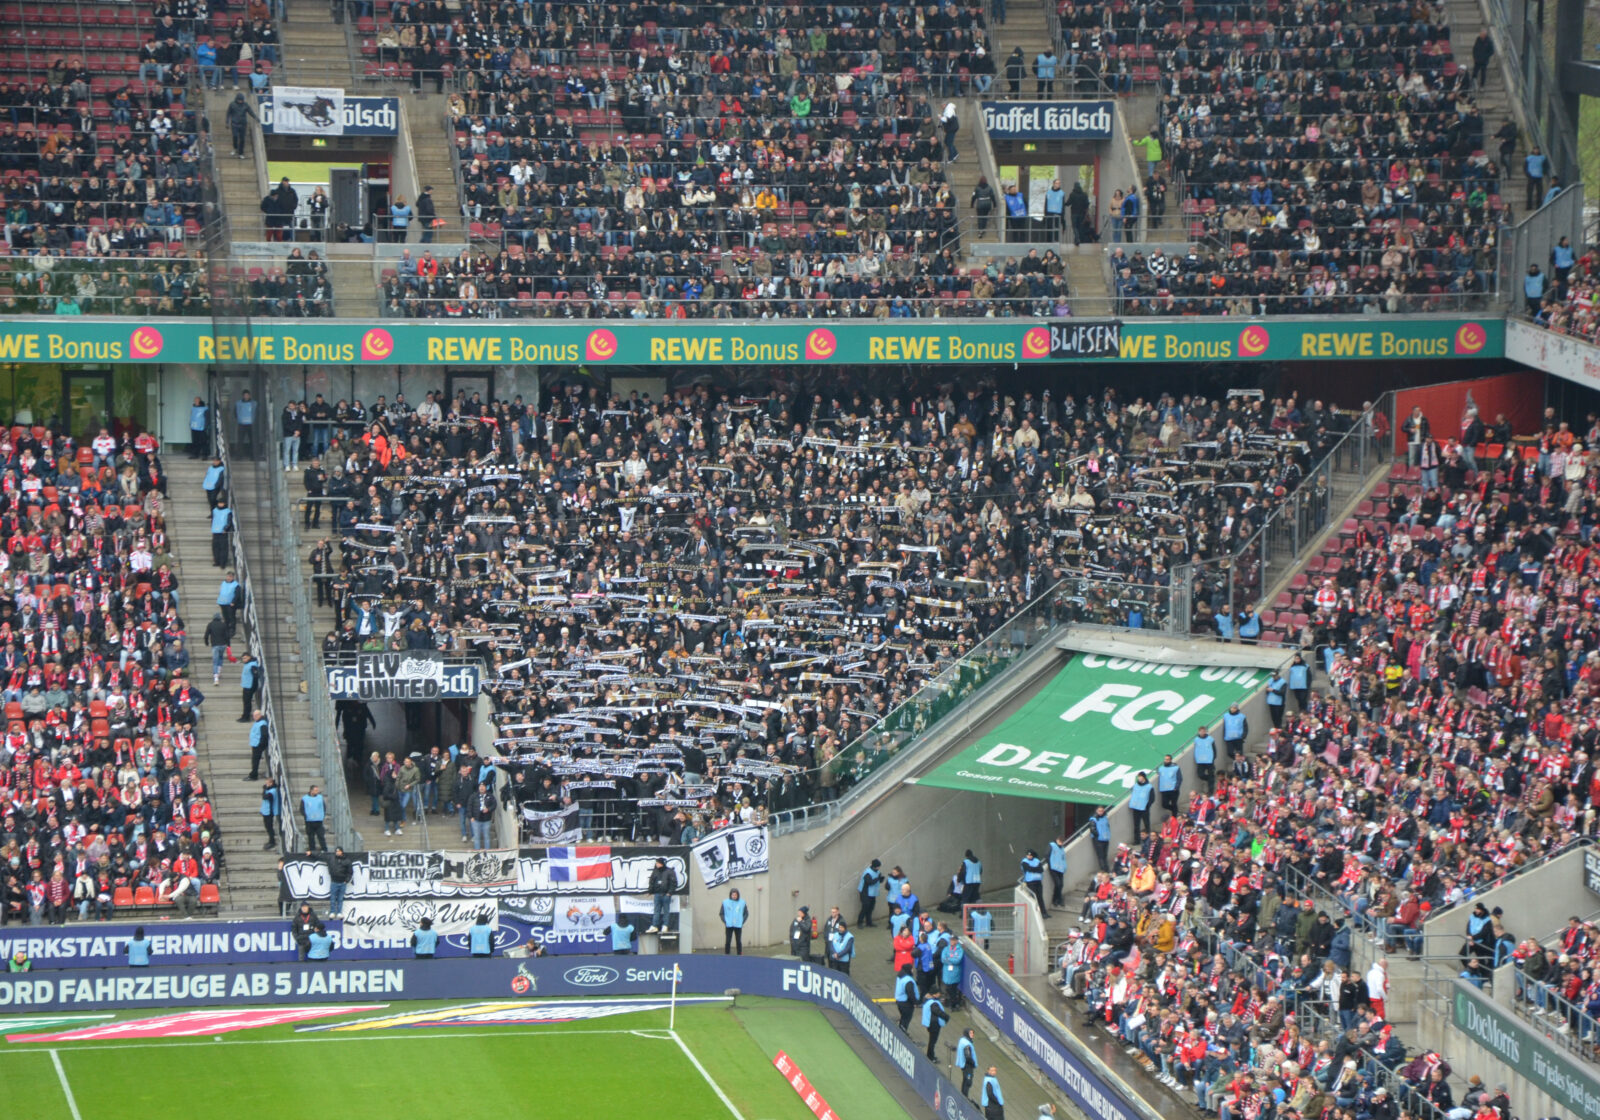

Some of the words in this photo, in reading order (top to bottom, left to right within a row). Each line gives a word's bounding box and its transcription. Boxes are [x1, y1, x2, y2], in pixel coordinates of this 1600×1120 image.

[343, 103, 397, 131] ölsch
[983, 106, 1041, 133] Gaffel
[1044, 106, 1111, 134] Kölsch
[0, 334, 40, 359] WE
[48, 333, 123, 360] Bonus
[198, 335, 276, 360] REWE
[283, 336, 354, 361] Bonus
[427, 337, 502, 361] REWE
[509, 337, 579, 361] Bonus
[650, 337, 723, 361] REWE
[731, 337, 799, 361] Bonus
[869, 336, 941, 360] REWE
[948, 335, 1015, 360] Bonus
[1119, 335, 1156, 359] WE
[1164, 334, 1231, 359] Bonus
[1301, 332, 1373, 357] REWE
[1380, 331, 1448, 356] Bonus
[358, 653, 400, 679] ELV
[357, 679, 440, 699] UNITED
[441, 668, 475, 696] sch
[1060, 683, 1216, 736] FC!
[976, 743, 1157, 789] DEVK
[369, 868, 426, 880] KOLLEKTIV
[343, 906, 397, 934] Loyal
[438, 902, 496, 923] Unity
[0, 933, 229, 960] WERKSTATTERMIN
[233, 931, 298, 953] ONLI
[530, 926, 608, 945] Service
[0, 980, 55, 1006] ORD
[59, 974, 226, 1004] FAHRZEUGE
[230, 972, 269, 998] AB
[275, 972, 292, 996] 5
[296, 968, 404, 996] JAHREN
[574, 968, 609, 984] Ford
[783, 965, 821, 997] FÜR
[823, 976, 852, 1011] FORD
[1466, 1000, 1520, 1063] DocMorris
